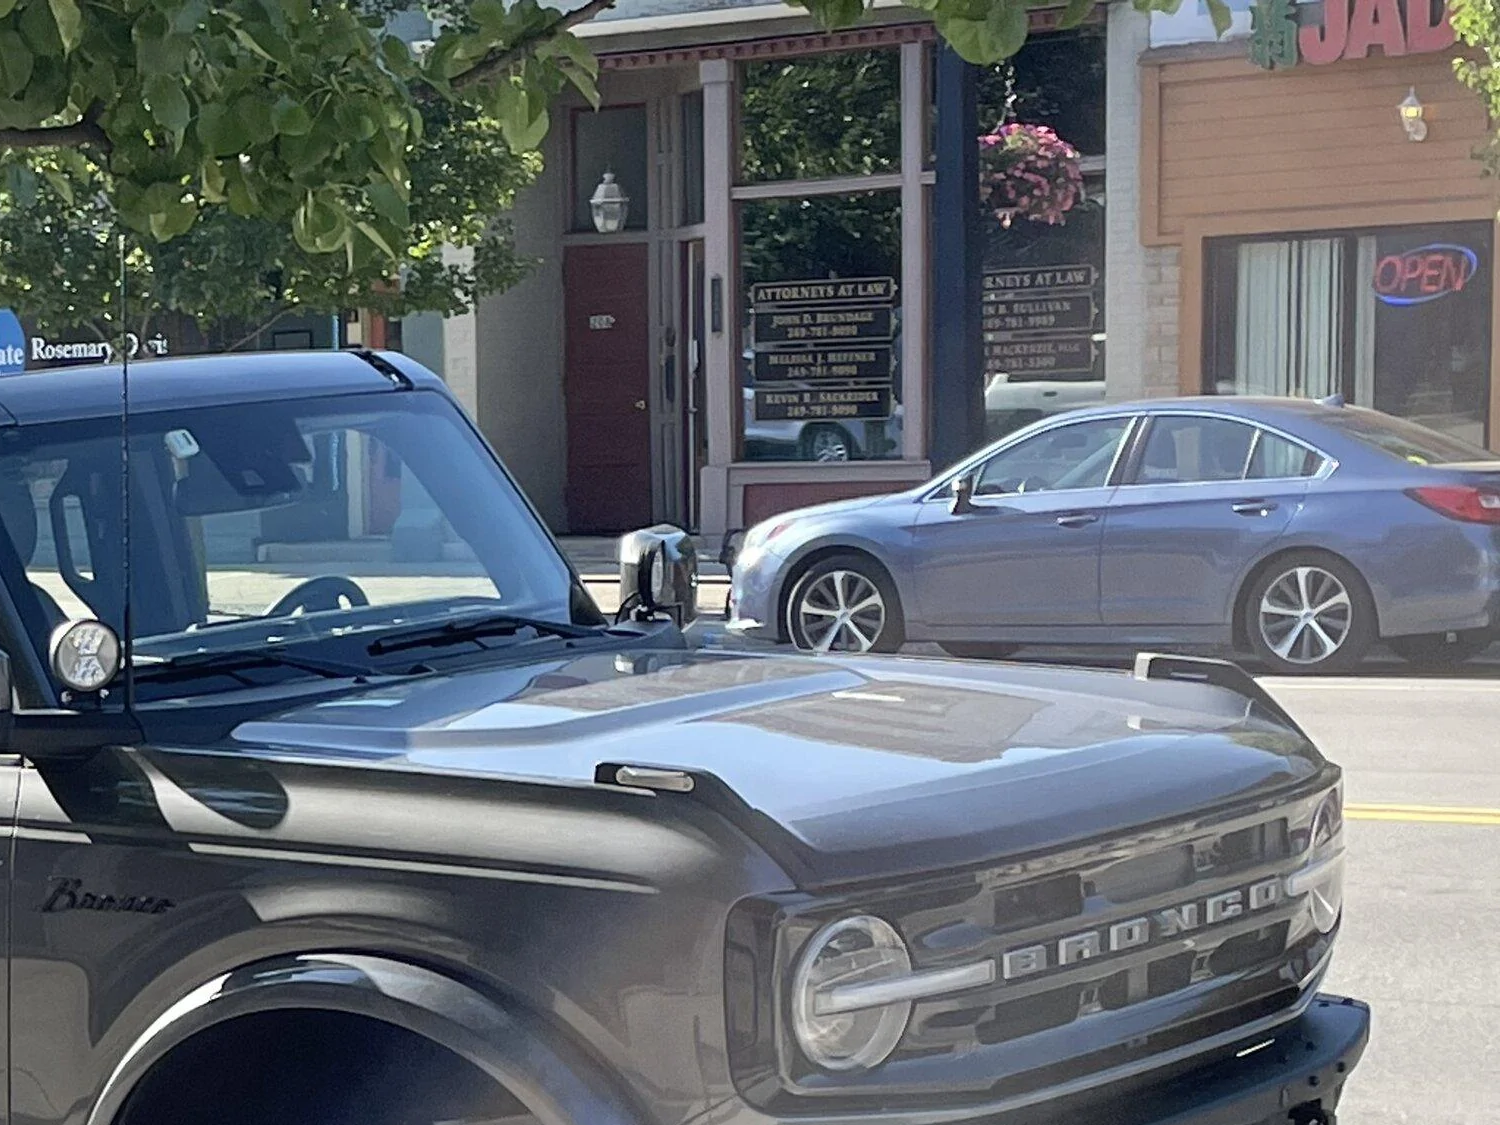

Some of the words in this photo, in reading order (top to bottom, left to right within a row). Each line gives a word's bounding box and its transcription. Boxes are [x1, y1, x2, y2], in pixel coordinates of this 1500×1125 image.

[1034, 272, 1052, 286] AT
[1056, 271, 1086, 285] LAW
[1375, 253, 1465, 293] OPEN
[757, 285, 834, 300] ATTORNEYS
[838, 284, 854, 297] AT
[857, 282, 887, 296] LAW
[31, 337, 113, 365] Rosemary
[766, 393, 799, 405] KEVIN
[1002, 876, 1281, 980] BRONCO
